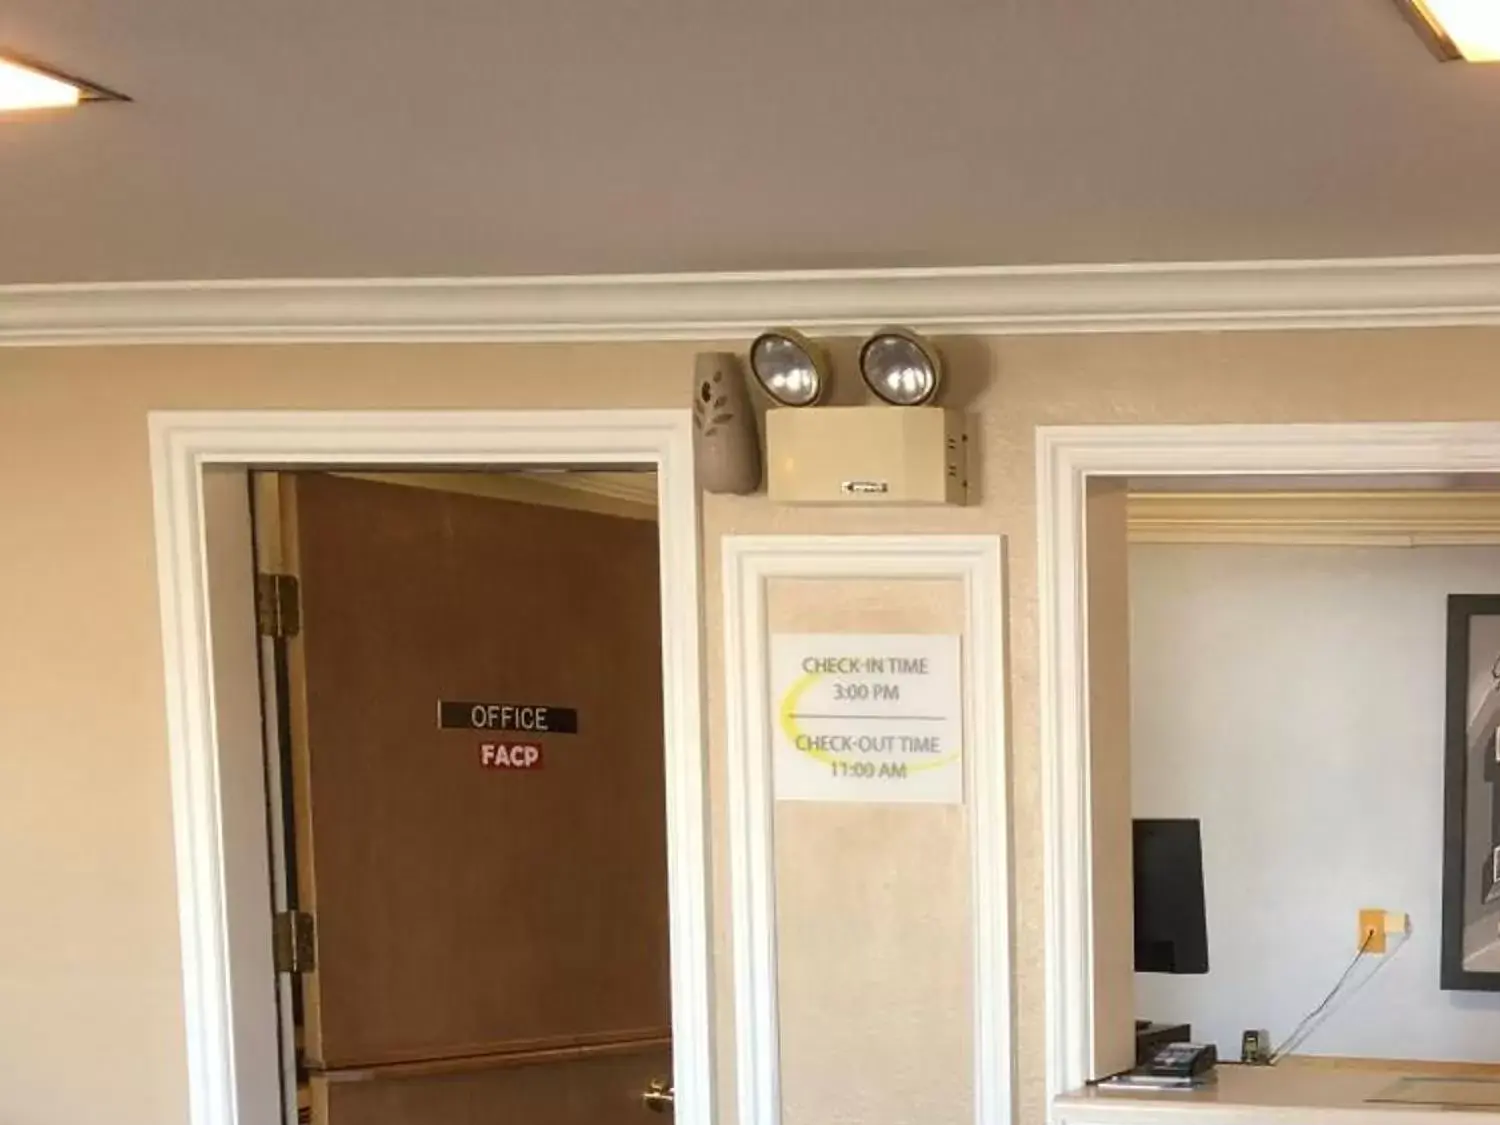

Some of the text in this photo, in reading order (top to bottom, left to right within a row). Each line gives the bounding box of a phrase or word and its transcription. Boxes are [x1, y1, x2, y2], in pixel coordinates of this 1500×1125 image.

[802, 656, 929, 674] CHECK-IN TIME
[833, 683, 899, 700] 3:00 PM
[471, 704, 549, 731] OFFICE
[795, 734, 942, 753] CHECK-OUT TIME
[481, 744, 539, 768] FACP
[831, 760, 907, 778] 11:00 AM
